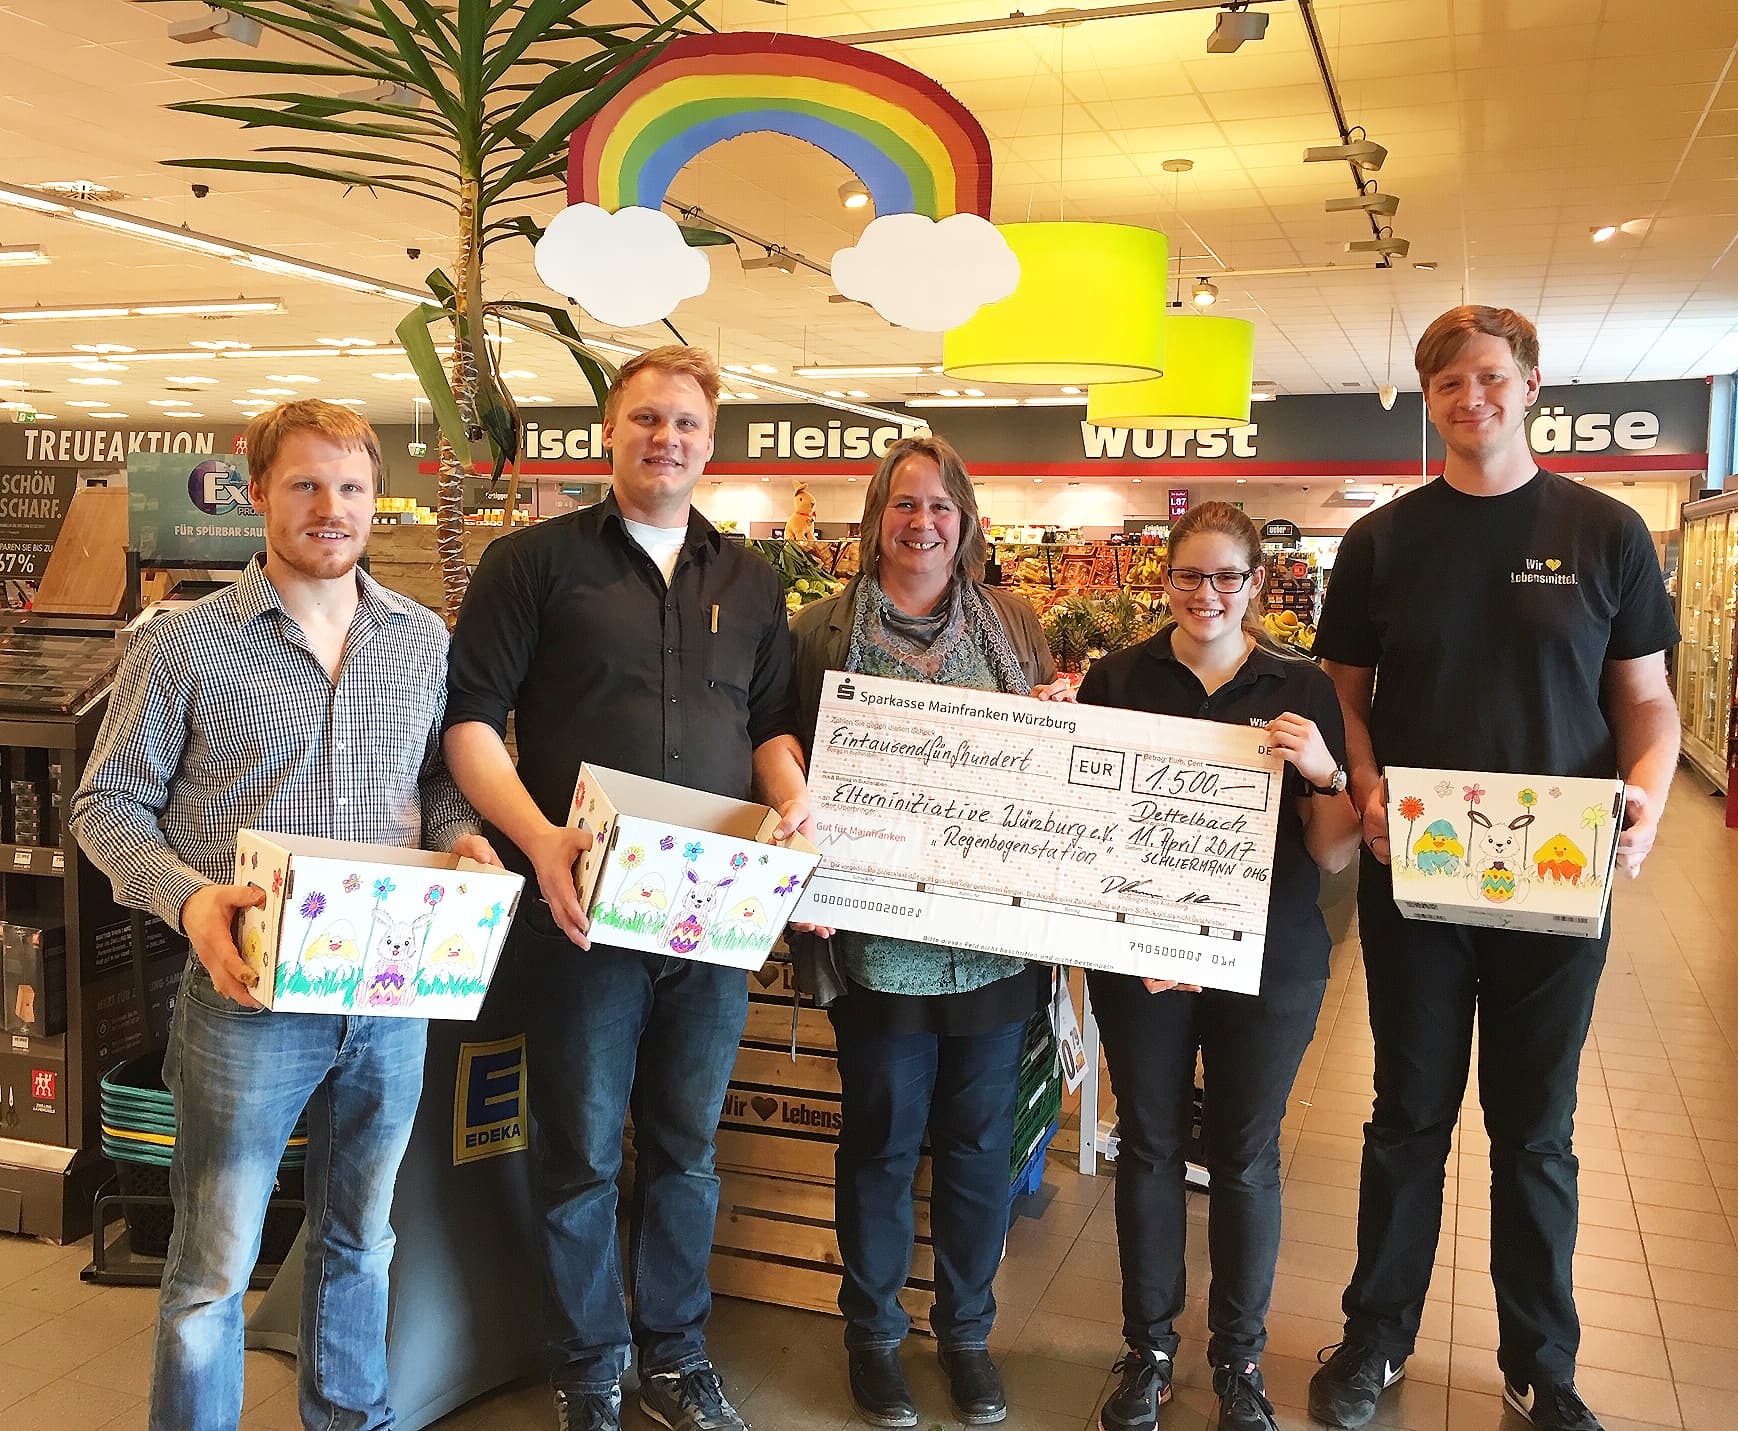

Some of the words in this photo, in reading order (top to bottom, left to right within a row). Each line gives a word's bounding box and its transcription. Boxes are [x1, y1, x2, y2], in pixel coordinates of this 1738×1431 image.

[1080, 421, 1258, 458] Wurst
[1529, 406, 1660, 453] äse
[24, 430, 214, 461] TREUEAKTION
[1, 470, 55, 494] SCHÖN
[1170, 497, 1187, 506] L87
[174, 524, 194, 536] FÜR
[196, 525, 242, 537] SPÜRBAR
[21, 543, 32, 552] SIE
[32, 544, 43, 552] BIS
[44, 544, 54, 553] ZU
[1526, 558, 1543, 571] Wir
[860, 691, 925, 711] Sparkasse
[928, 700, 1009, 722] Mainfranken
[1012, 711, 1076, 734] Würzburg
[1250, 717, 1267, 728] Wir
[1079, 759, 1113, 777] EUR
[832, 783, 991, 823] Elterninitiative
[1002, 804, 1087, 849] Würzburg
[1128, 800, 1248, 834] Dettelbach
[816, 821, 832, 832] Gut
[834, 824, 847, 834] für
[849, 826, 907, 842] Mainfranken
[1128, 825, 1154, 847] 11.
[1161, 827, 1201, 857] April
[1205, 836, 1256, 861] 2017
[1243, 867, 1270, 881] OHG
[465, 1123, 521, 1148] EDEKA
